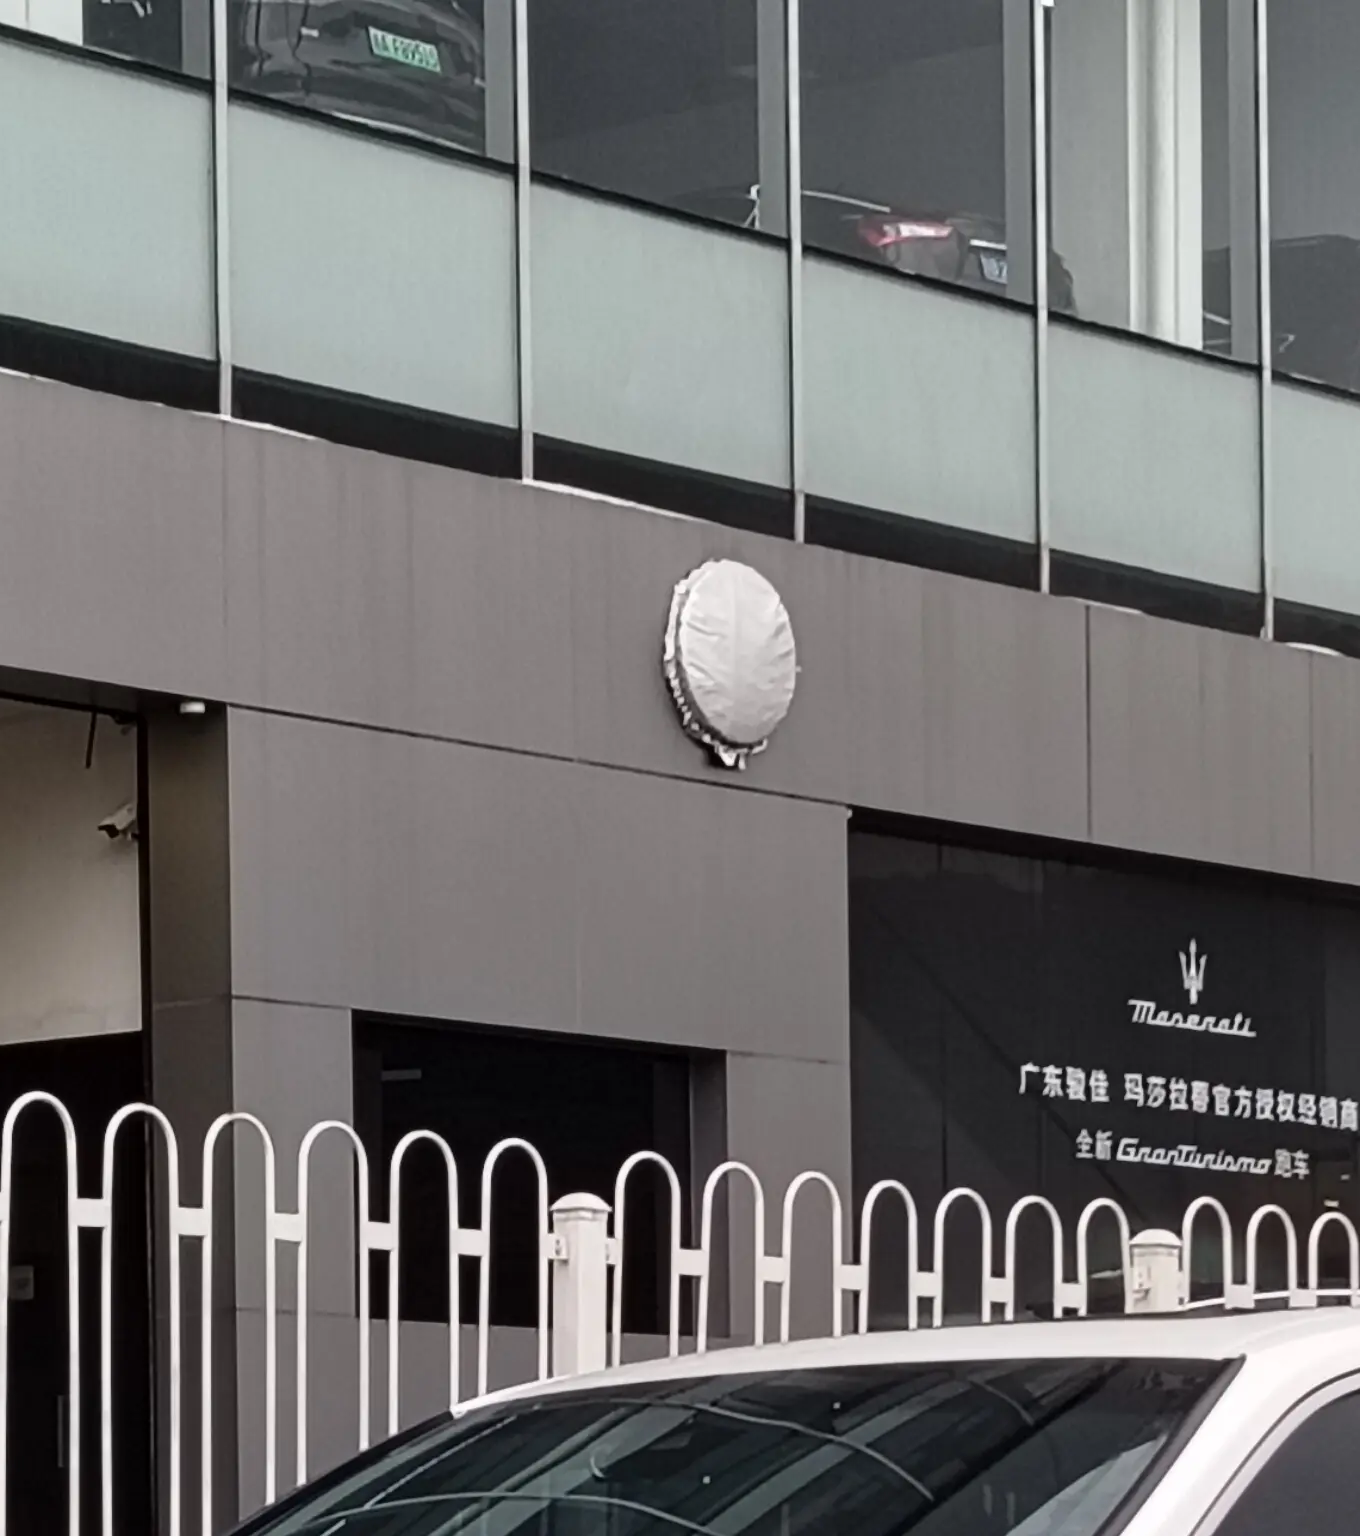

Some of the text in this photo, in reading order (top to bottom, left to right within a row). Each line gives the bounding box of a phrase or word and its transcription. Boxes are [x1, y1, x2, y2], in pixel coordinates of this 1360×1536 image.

[1127, 998, 1257, 1038] Maserati
[1075, 1128, 1113, 1161] 全新
[1116, 1137, 1273, 1175] GranTurismo
